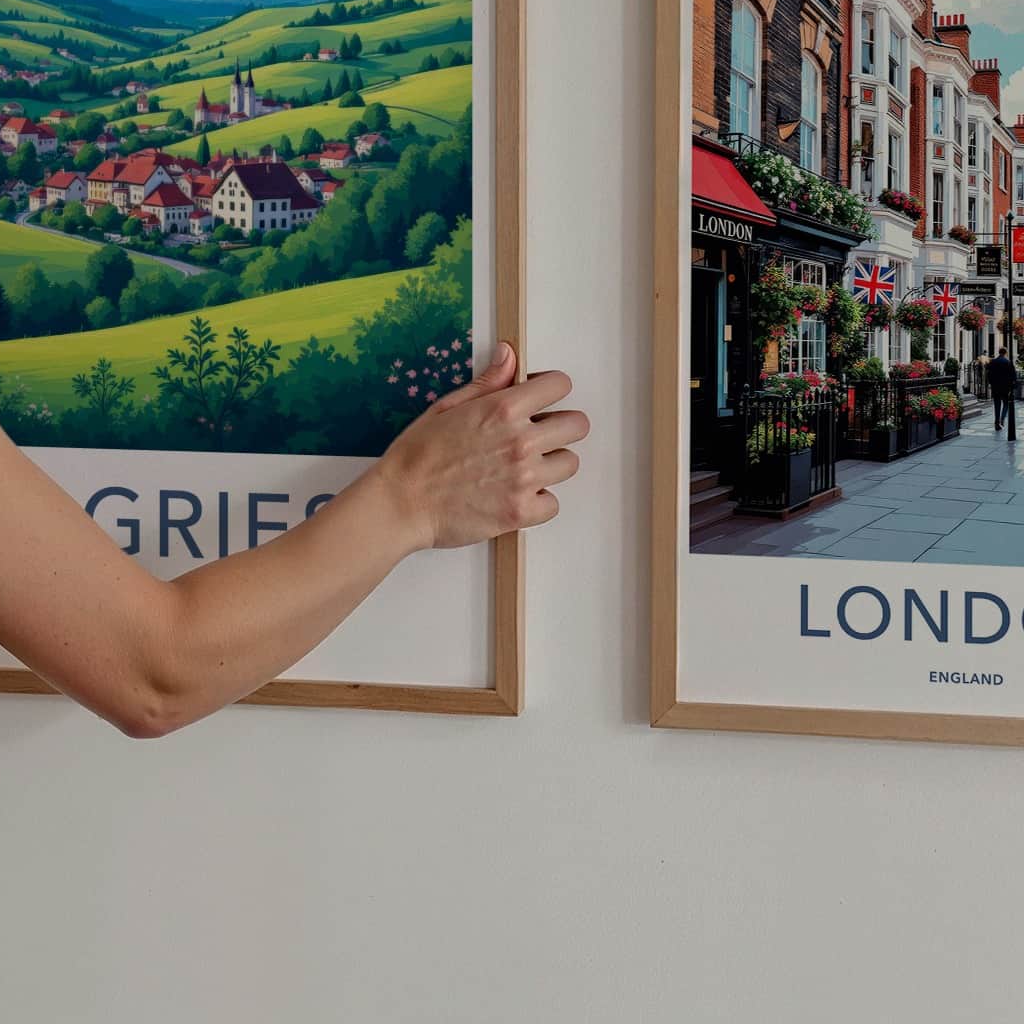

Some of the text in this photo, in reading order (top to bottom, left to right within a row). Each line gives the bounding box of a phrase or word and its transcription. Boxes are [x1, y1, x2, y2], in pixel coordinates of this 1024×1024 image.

[698, 213, 753, 242] LONDON
[800, 584, 1024, 645] LOND
[929, 671, 1004, 686] ENGLAND
